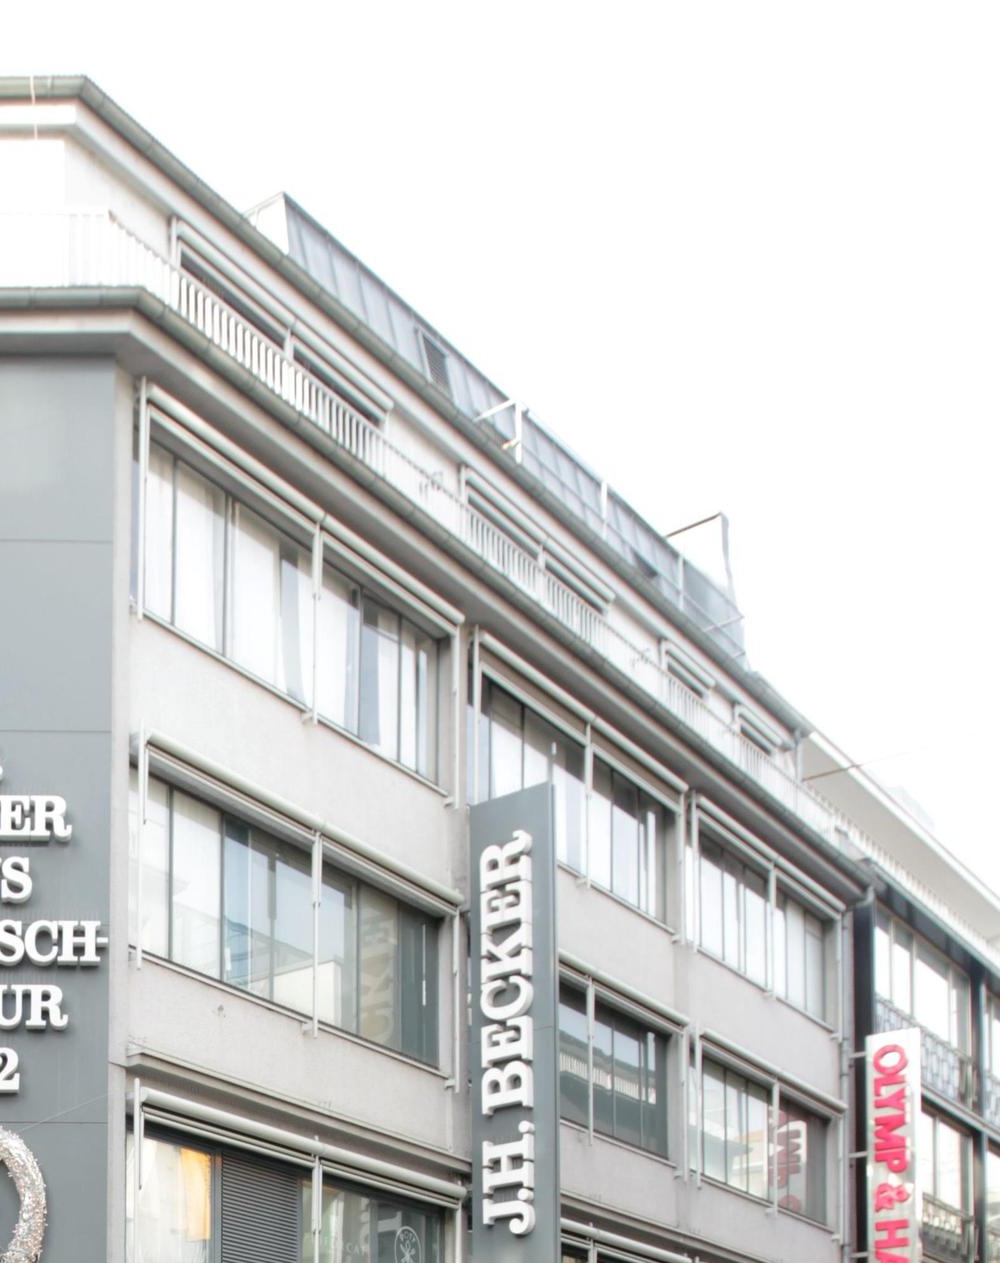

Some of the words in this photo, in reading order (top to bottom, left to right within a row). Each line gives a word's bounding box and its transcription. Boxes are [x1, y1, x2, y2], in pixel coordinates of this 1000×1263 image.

[479, 829, 534, 1117] BECKER
[872, 1043, 911, 1176] OLYMP
[482, 1120, 536, 1236] J.H.
[873, 1180, 912, 1212] &
